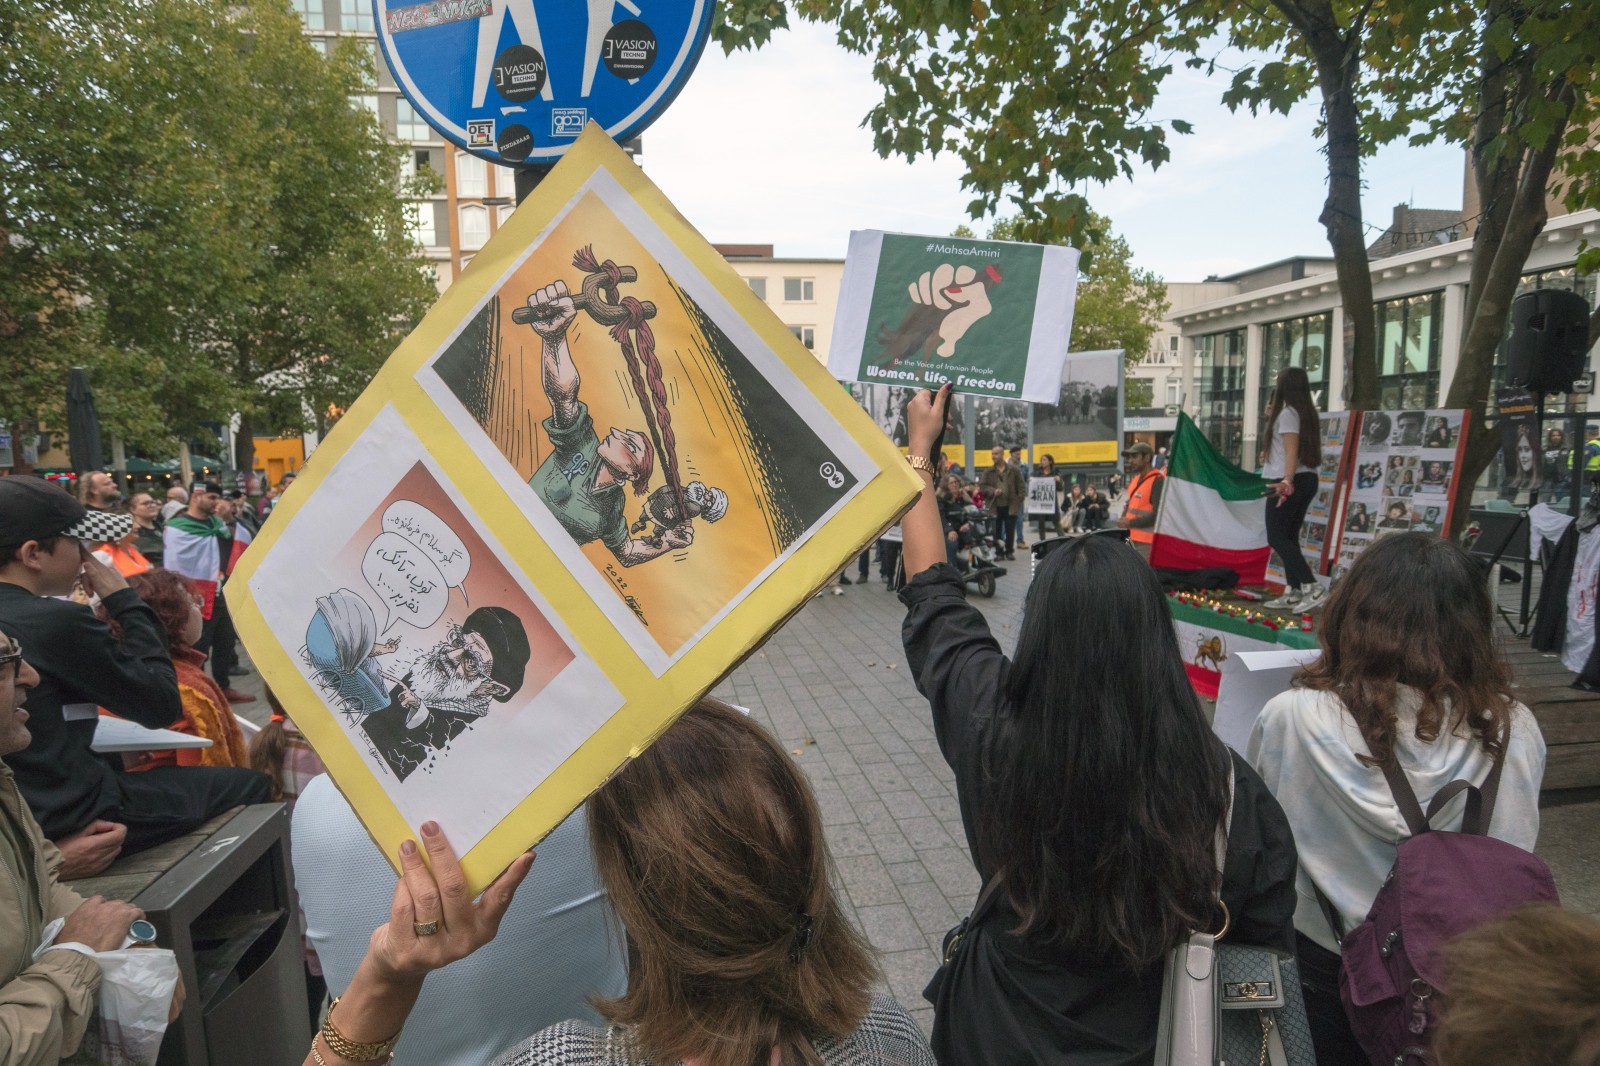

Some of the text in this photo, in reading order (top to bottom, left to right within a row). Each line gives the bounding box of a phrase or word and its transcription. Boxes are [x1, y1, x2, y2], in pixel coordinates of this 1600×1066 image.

[514, 75, 535, 83] TECHNO
[468, 124, 493, 134] OET
[925, 243, 1001, 258] #MahsaAmini
[916, 360, 936, 369] Voice
[936, 361, 944, 369] of
[945, 363, 969, 372] Iranian
[970, 365, 994, 375] People
[956, 374, 1017, 392] Freedom
[820, 462, 844, 488] DW
[418, 531, 444, 554] سلام
[606, 563, 628, 590] 2022
